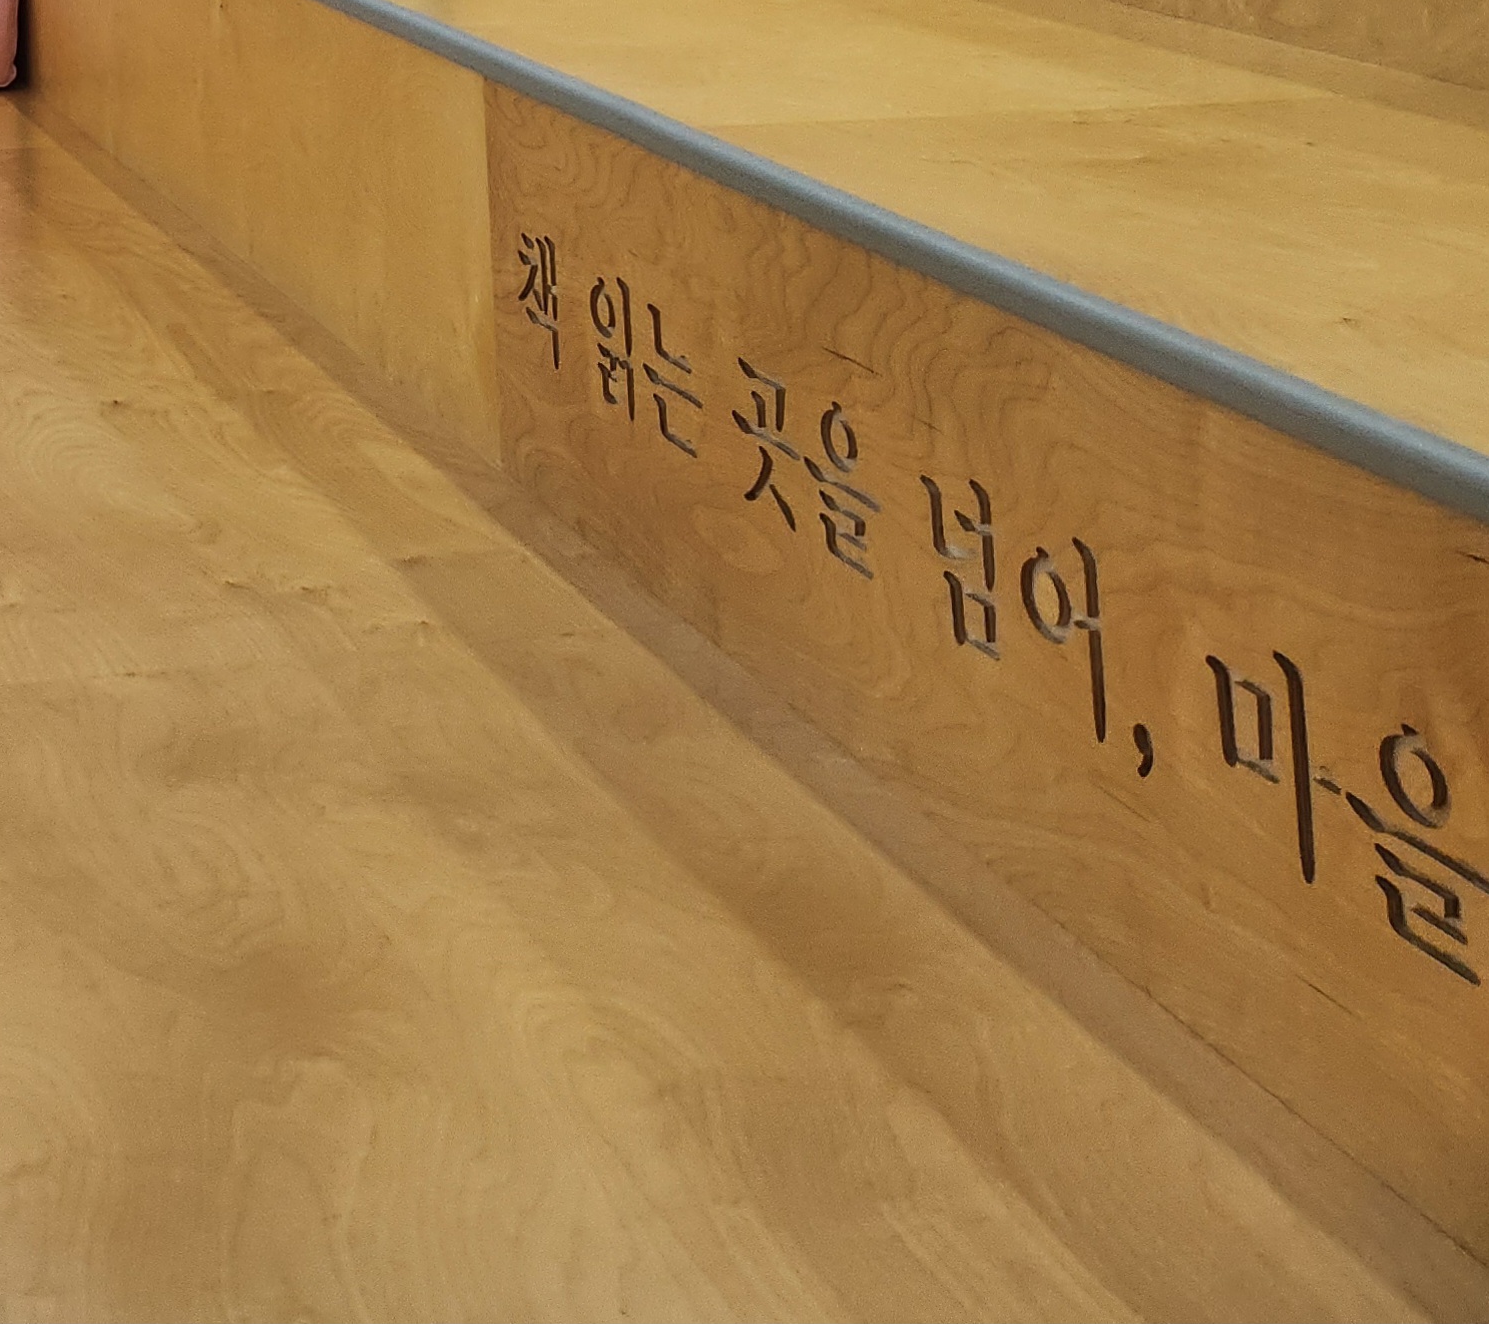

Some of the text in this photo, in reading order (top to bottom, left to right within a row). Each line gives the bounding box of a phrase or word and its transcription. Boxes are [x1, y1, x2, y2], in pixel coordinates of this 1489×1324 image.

[517, 232, 1489, 987] 책 읽는 곳을 넘어, 마을
